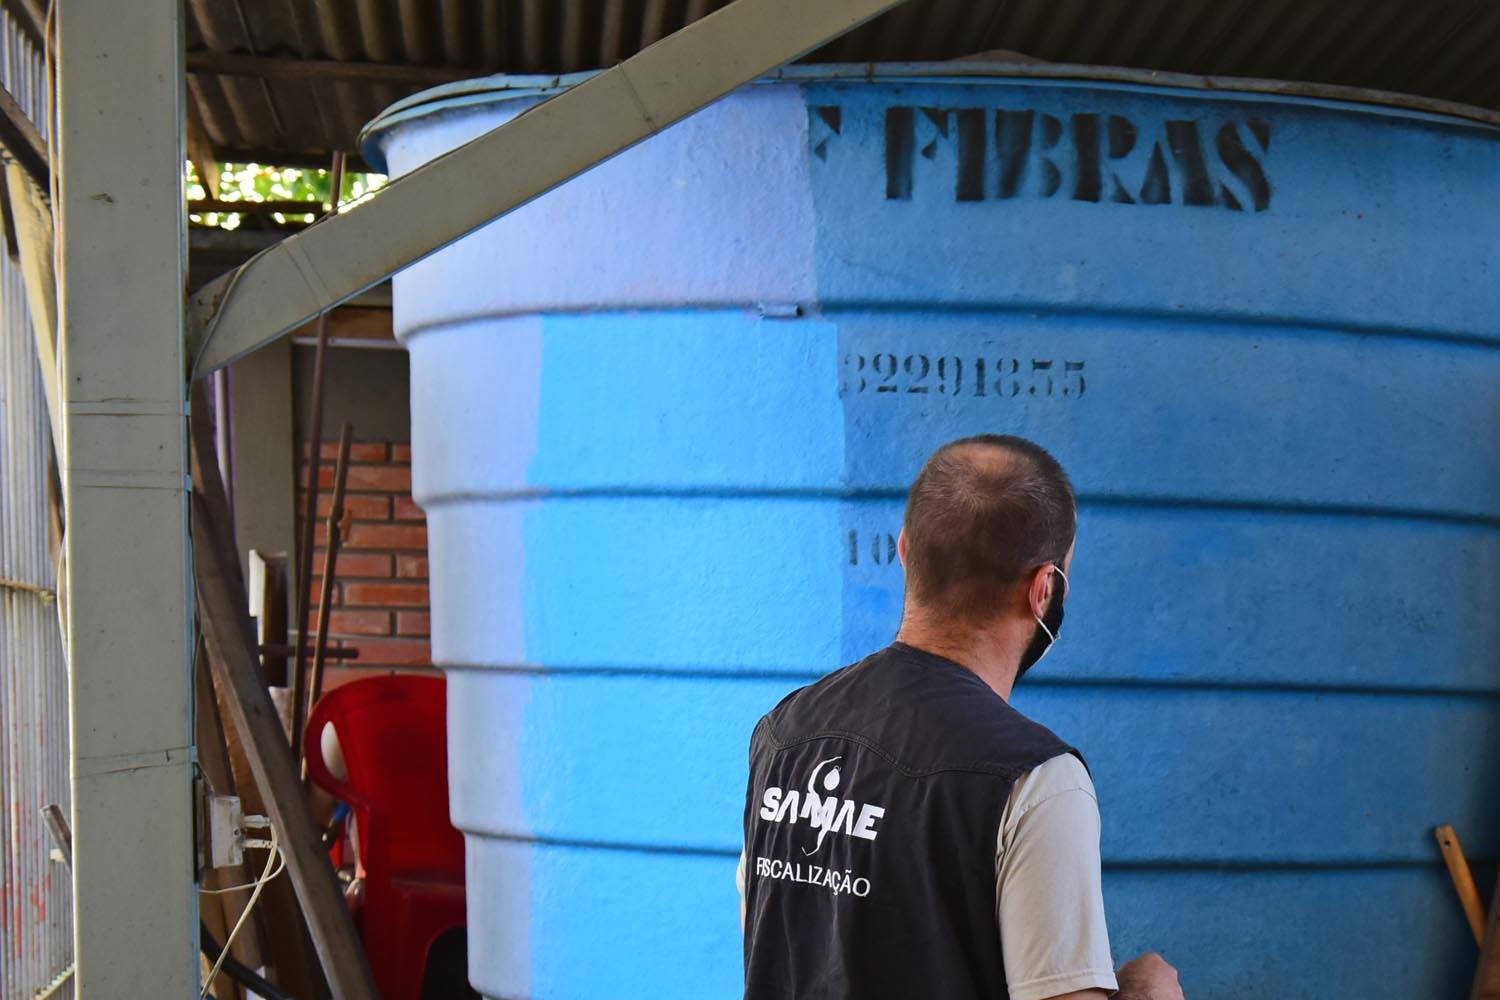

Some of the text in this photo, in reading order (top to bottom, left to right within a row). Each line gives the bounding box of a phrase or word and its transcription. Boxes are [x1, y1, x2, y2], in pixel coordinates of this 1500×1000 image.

[884, 106, 1273, 212] FIBRAS
[760, 787, 886, 841] SAMAE
[756, 856, 871, 897] FISCALIZAÇÃO
